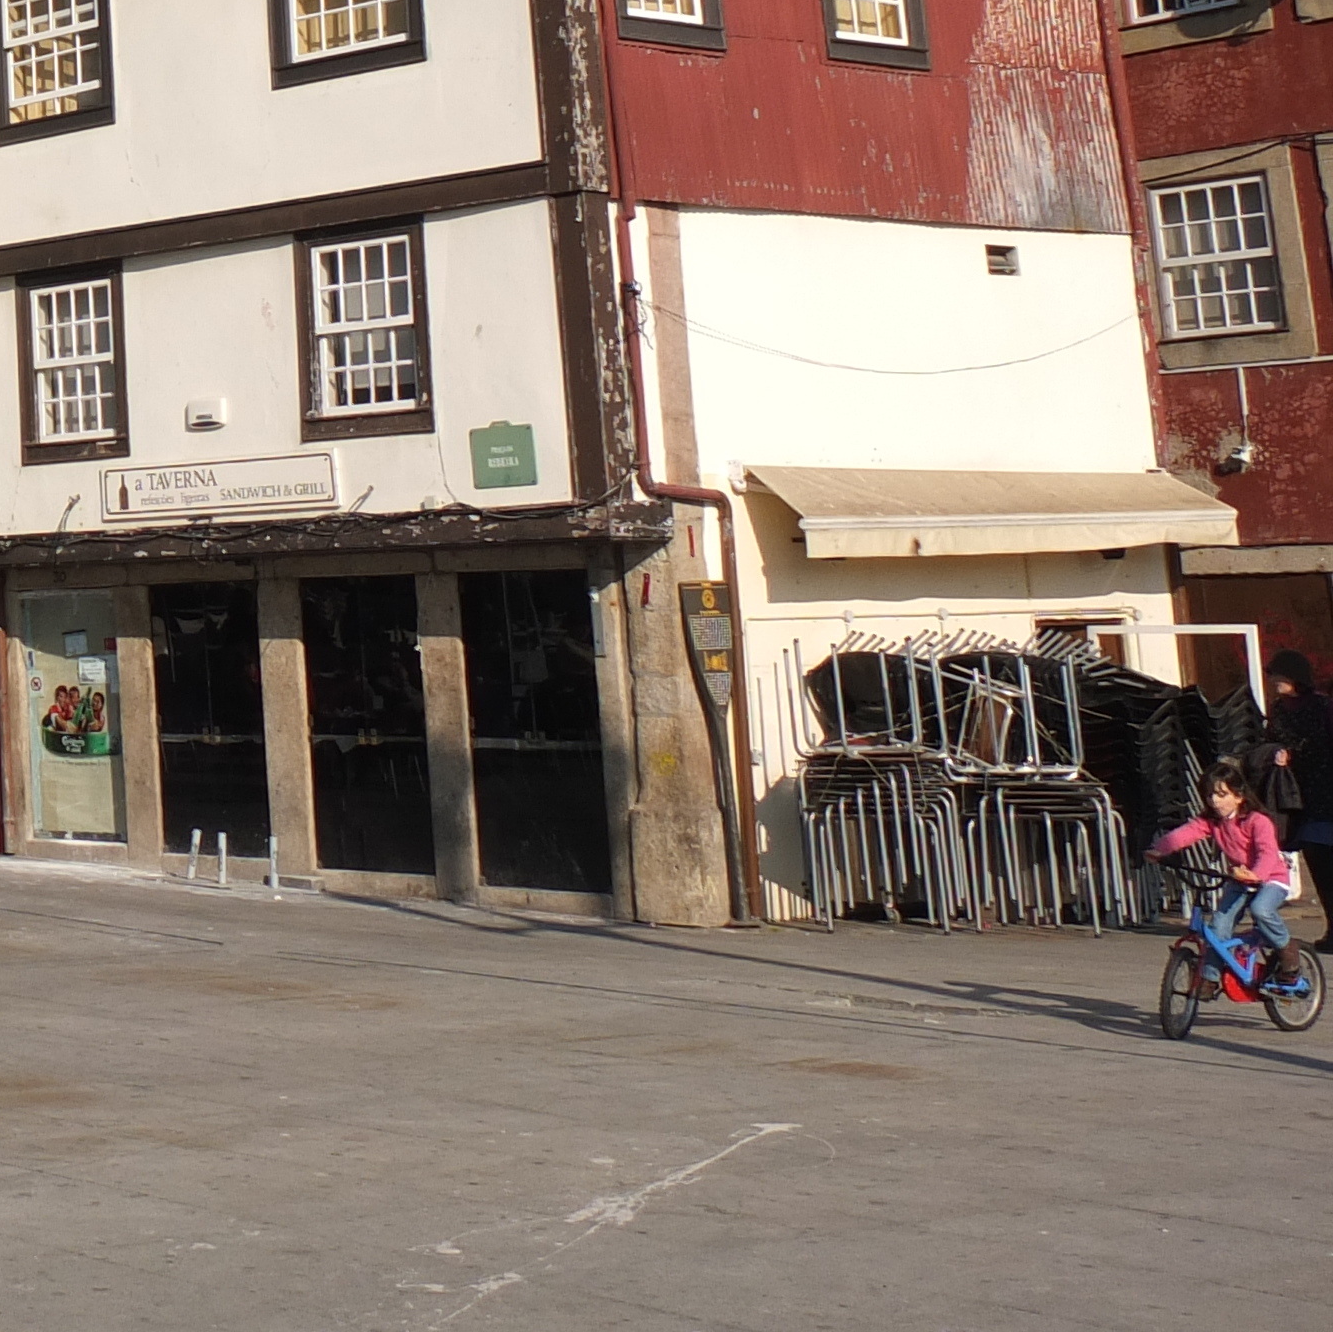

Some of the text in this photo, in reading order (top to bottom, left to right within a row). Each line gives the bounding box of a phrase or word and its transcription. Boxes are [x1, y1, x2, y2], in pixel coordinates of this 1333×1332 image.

[134, 469, 218, 491] a TAVERNA
[219, 484, 281, 500] SANDWICH
[283, 484, 293, 497] &
[294, 482, 328, 496] GRILL
